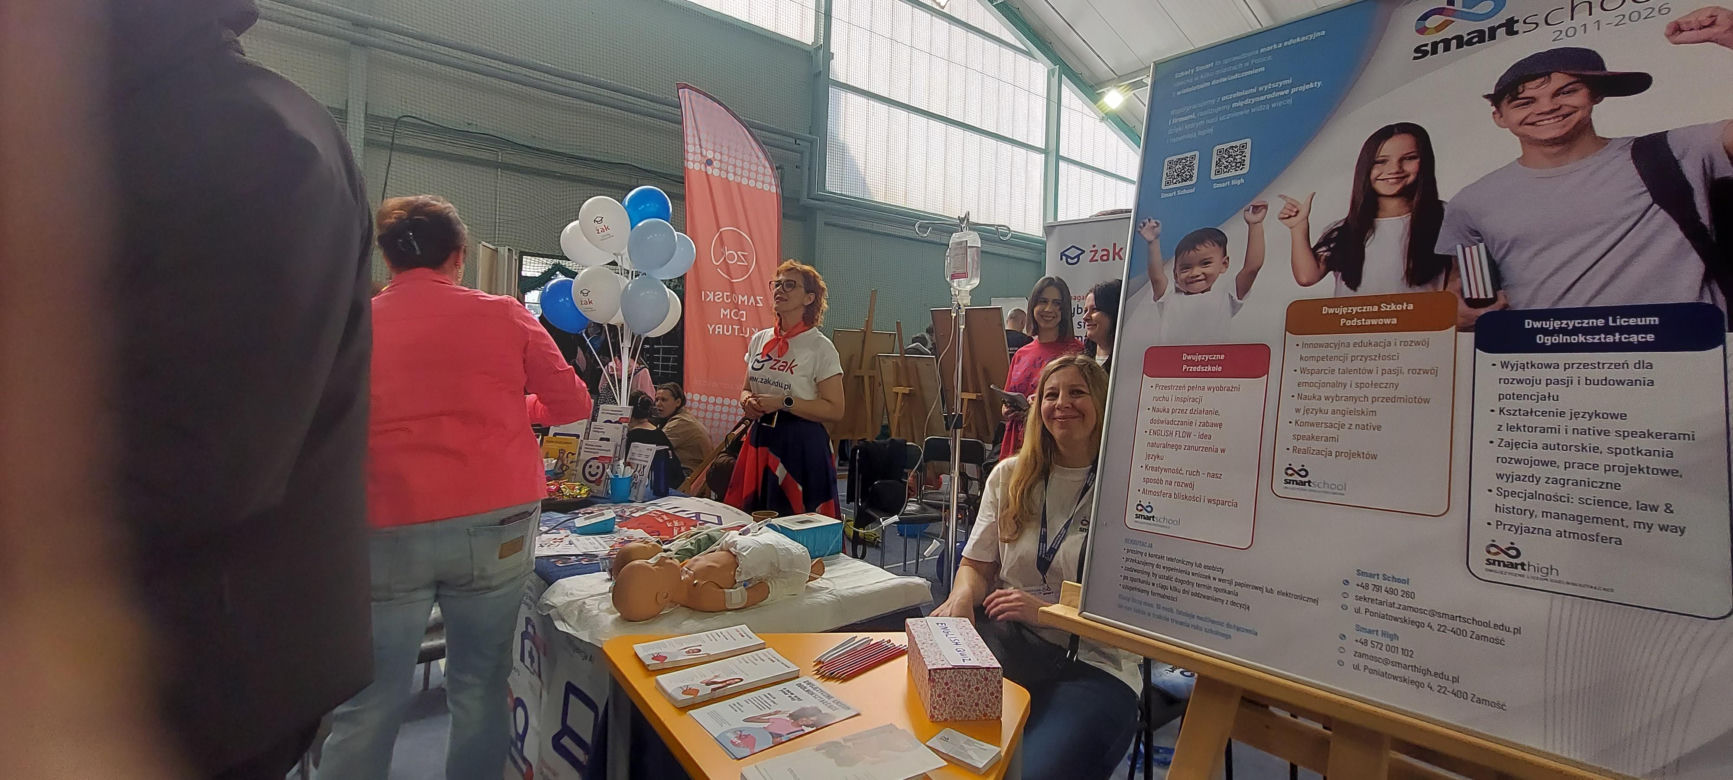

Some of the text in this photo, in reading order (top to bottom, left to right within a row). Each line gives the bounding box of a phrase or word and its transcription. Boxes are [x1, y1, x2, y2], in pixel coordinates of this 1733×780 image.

[1413, 0, 1652, 60] smartscho
[1552, 6, 1672, 42] 2011-2026
[1088, 242, 1124, 262] żak
[1322, 302, 1413, 315] Dwujęzyczna Szkoła
[1340, 317, 1397, 326] Podstawowa
[1524, 315, 1659, 330] Dwujęzyczne Liceum
[1301, 340, 1350, 350] Innowacyjna
[1352, 339, 1392, 349] edukacja
[1399, 338, 1429, 348] rozwój
[1536, 332, 1655, 346] Ogólnokształcące
[1182, 352, 1225, 361] Dwujęzyczne
[1299, 353, 1348, 363] kompetencji
[1299, 366, 1336, 376] Wsparcie
[1337, 366, 1374, 375] talentów
[1407, 368, 1438, 377] rozwój
[1500, 359, 1653, 372] Wyjątkowa przestrzeń dla
[1186, 384, 1205, 392] pełna
[1206, 384, 1240, 393] wyobraźni
[1297, 379, 1399, 391] emocjonalny i społeczny
[1498, 375, 1654, 388] rozwoju pasji i budowania
[1174, 395, 1203, 405] inspiracji
[1296, 392, 1431, 404] Nauka wybranych przedmiotów
[1498, 391, 1559, 403] potencjału
[1151, 405, 1170, 414] Nauka
[1302, 405, 1329, 416] języku
[1330, 407, 1377, 417] angielskim
[1498, 406, 1627, 421] Kształcenie językowe
[1198, 420, 1223, 430] zabawę
[1294, 418, 1346, 431] Konwersacje
[1354, 422, 1382, 431] native
[1506, 422, 1560, 434] lektorami
[1564, 424, 1568, 435] i
[1572, 426, 1611, 437] native
[1614, 428, 1695, 441] speakerami
[1148, 428, 1212, 440] ENGLISH FLOW idea
[1292, 433, 1339, 443] speakerami
[1146, 441, 1182, 451] naturalnego
[1183, 444, 1218, 453] zanurzenia
[1292, 445, 1378, 460] Realizacja projektów
[1497, 437, 1538, 450] Zajęcia
[1606, 445, 1674, 458] spotkania
[1144, 452, 1164, 462] języku
[1564, 461, 1599, 471] prace
[1206, 471, 1222, 479] nasz
[1495, 471, 1621, 490] wyjazdy zagraniczne
[1142, 477, 1164, 485] sposób
[1173, 480, 1194, 491] rozwój
[1283, 477, 1347, 491] smartschool
[1141, 487, 1172, 498] Atmosfera
[1173, 491, 1202, 503] bliskości
[1206, 498, 1238, 508] wsparcia
[1496, 486, 1574, 504] Specjalności:
[1636, 500, 1659, 512] law
[1663, 502, 1674, 514] &
[1134, 513, 1180, 526] smartschool
[1495, 519, 1622, 545] Przyjazna atmosfera
[1633, 520, 1654, 533] my
[1657, 523, 1686, 537] way
[1484, 557, 1558, 576] smarthigh
[1356, 568, 1410, 585] Smart School
[1371, 583, 1382, 593] 791
[1384, 586, 1398, 596] 490
[1400, 589, 1415, 600] 260
[1354, 594, 1521, 636] sekretariat.zamosc@smartschool.edu.pl
[936, 622, 961, 646] ENGLISH
[1354, 623, 1399, 641] Smart High
[1364, 608, 1425, 629] Poniatowskiego
[1436, 623, 1468, 638] 22-400
[1469, 630, 1505, 646] Zamość
[1370, 639, 1383, 651] 572
[1385, 643, 1399, 654] 001
[1400, 647, 1414, 658] 102
[1353, 650, 1459, 684] zamosc@smarthigh.edu.pl
[1363, 664, 1425, 689] Poniatowskiego
[1436, 684, 1468, 700] 22-400
[1470, 693, 1506, 711] Zamość
